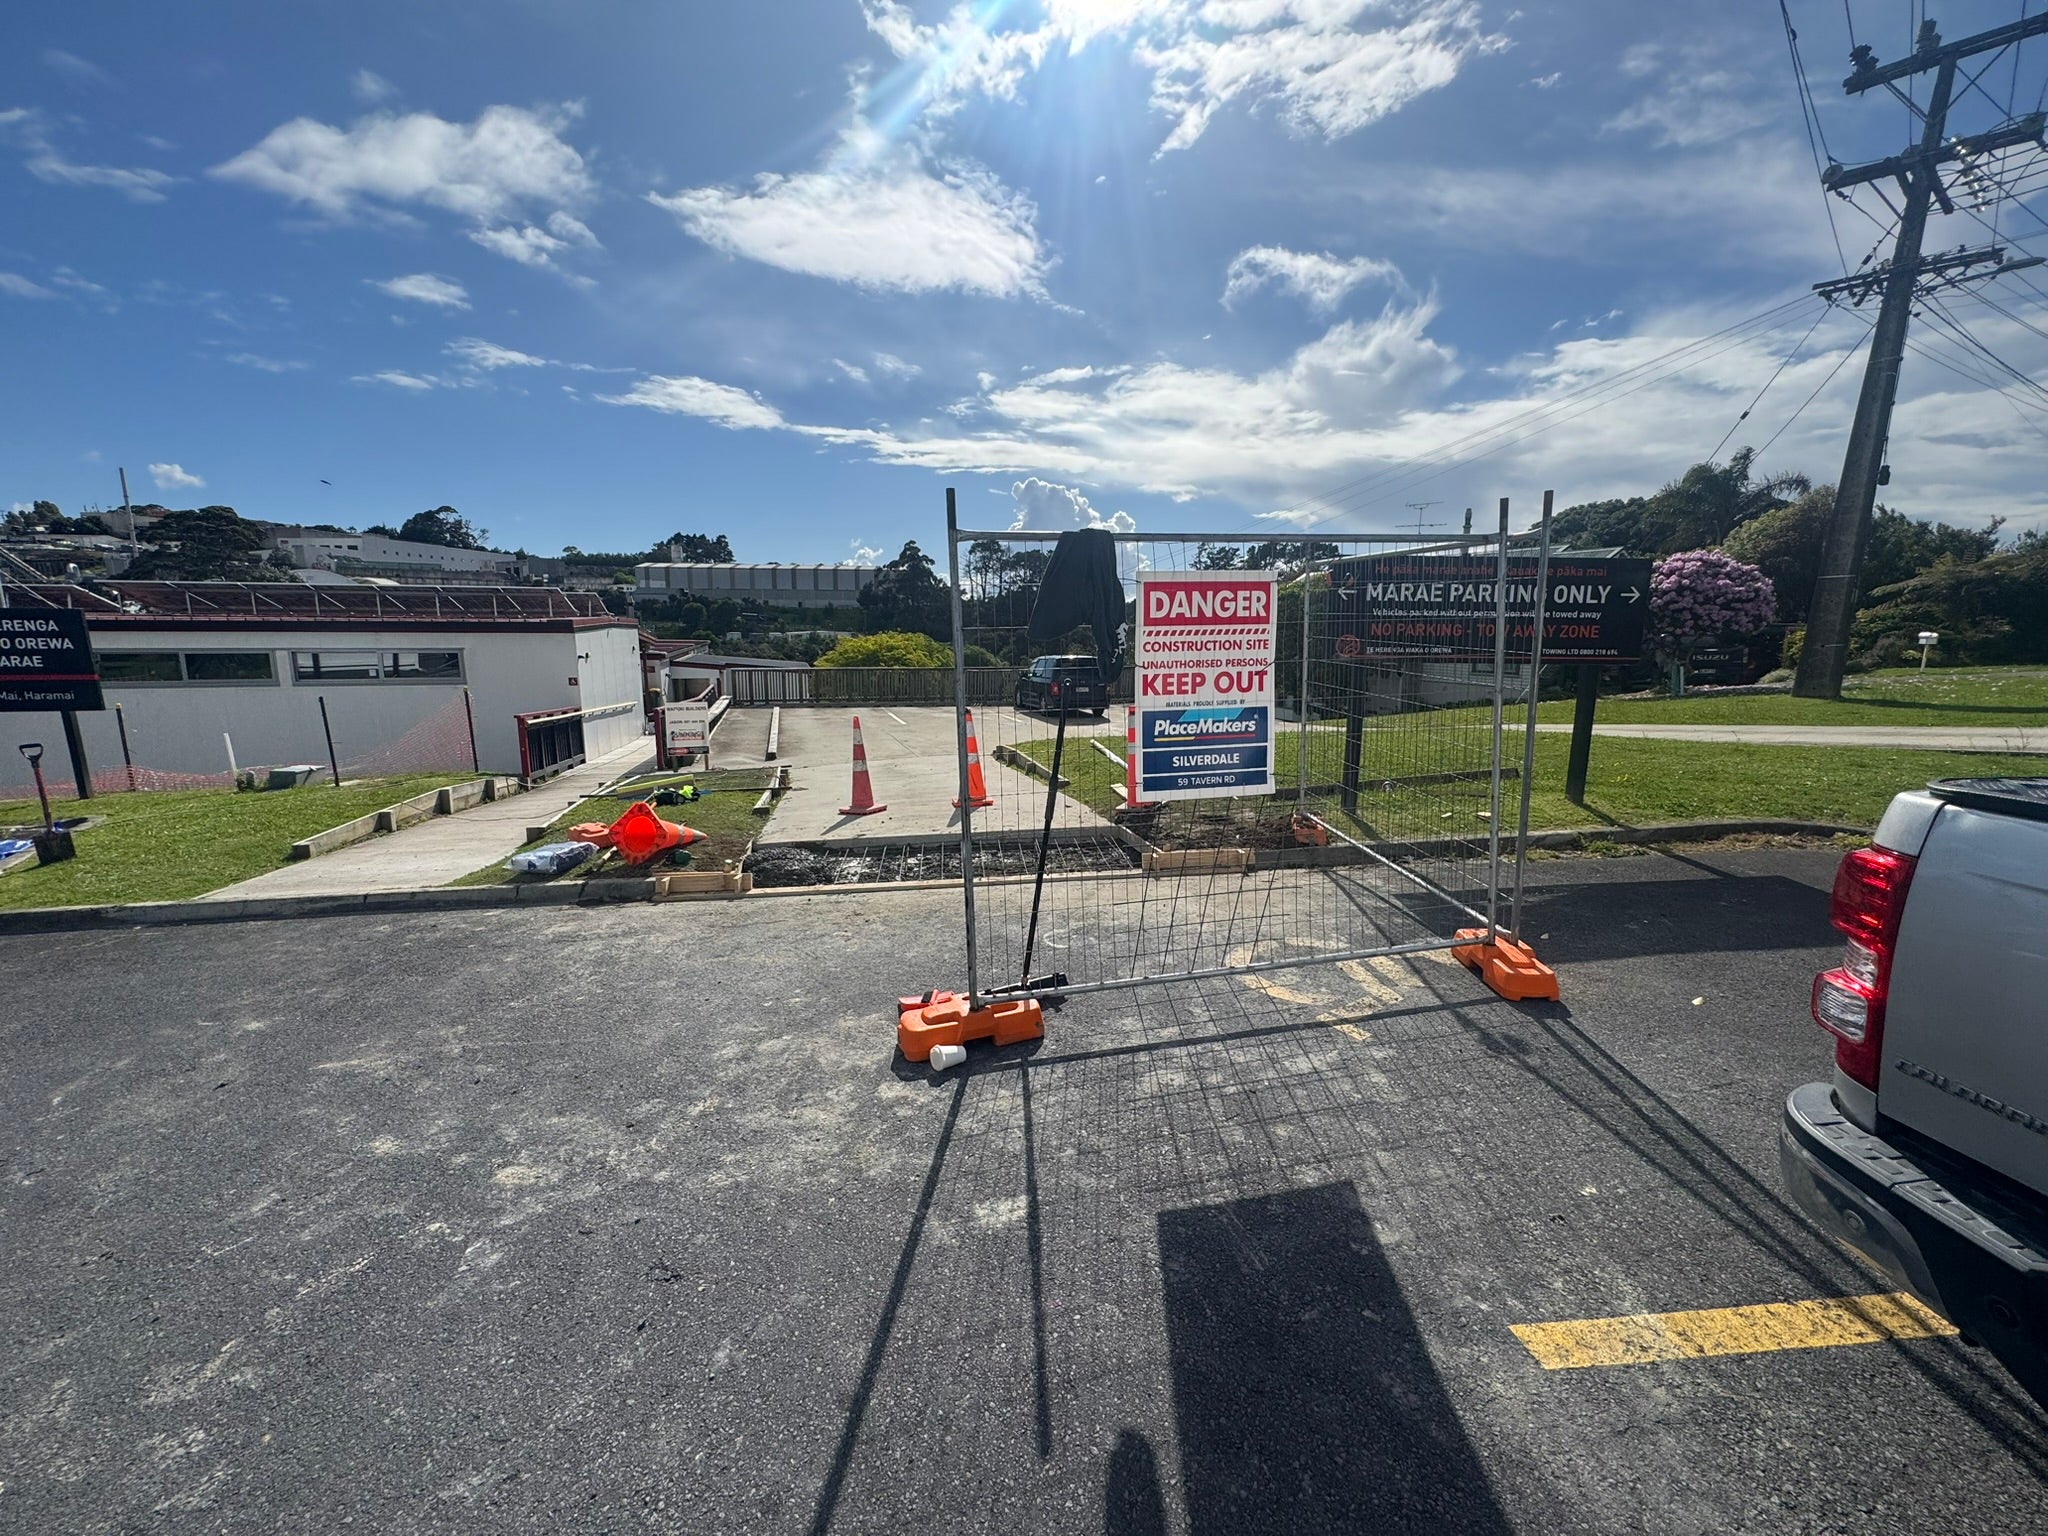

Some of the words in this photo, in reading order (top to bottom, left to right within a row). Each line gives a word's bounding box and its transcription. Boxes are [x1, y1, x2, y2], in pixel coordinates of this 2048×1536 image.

[1504, 566, 1544, 576] Kauak
[1557, 566, 1583, 578] pāka
[1587, 567, 1608, 577] mai
[1366, 583, 1443, 602] MARAE
[1450, 584, 1547, 604] PARIN
[1553, 585, 1612, 604] ONLY
[1149, 590, 1267, 619] DANGER
[1373, 608, 1408, 616] Vehicles
[1579, 612, 1602, 620] away
[0, 620, 59, 632] RENGA
[1371, 623, 1392, 637] NO
[1396, 623, 1463, 637] PARKING
[1559, 625, 1600, 639] ZONE
[15, 638, 74, 649] OREWA
[1143, 640, 1242, 653] CONSTRUCTION
[1245, 639, 1269, 650] SITE
[0, 656, 44, 667] ARAE
[1142, 659, 1223, 670] UNAUTHORISED
[1225, 658, 1268, 669] PERSONS
[1142, 673, 1206, 696] KEEP
[1214, 671, 1268, 694] OUT
[25, 691, 75, 700] Haramai
[1154, 717, 1256, 736] PlaceMakers
[1172, 753, 1240, 767] SILVERDALE
[1177, 777, 1189, 786] 59
[1190, 776, 1222, 786] TAVERN
[1223, 776, 1235, 784] RD
